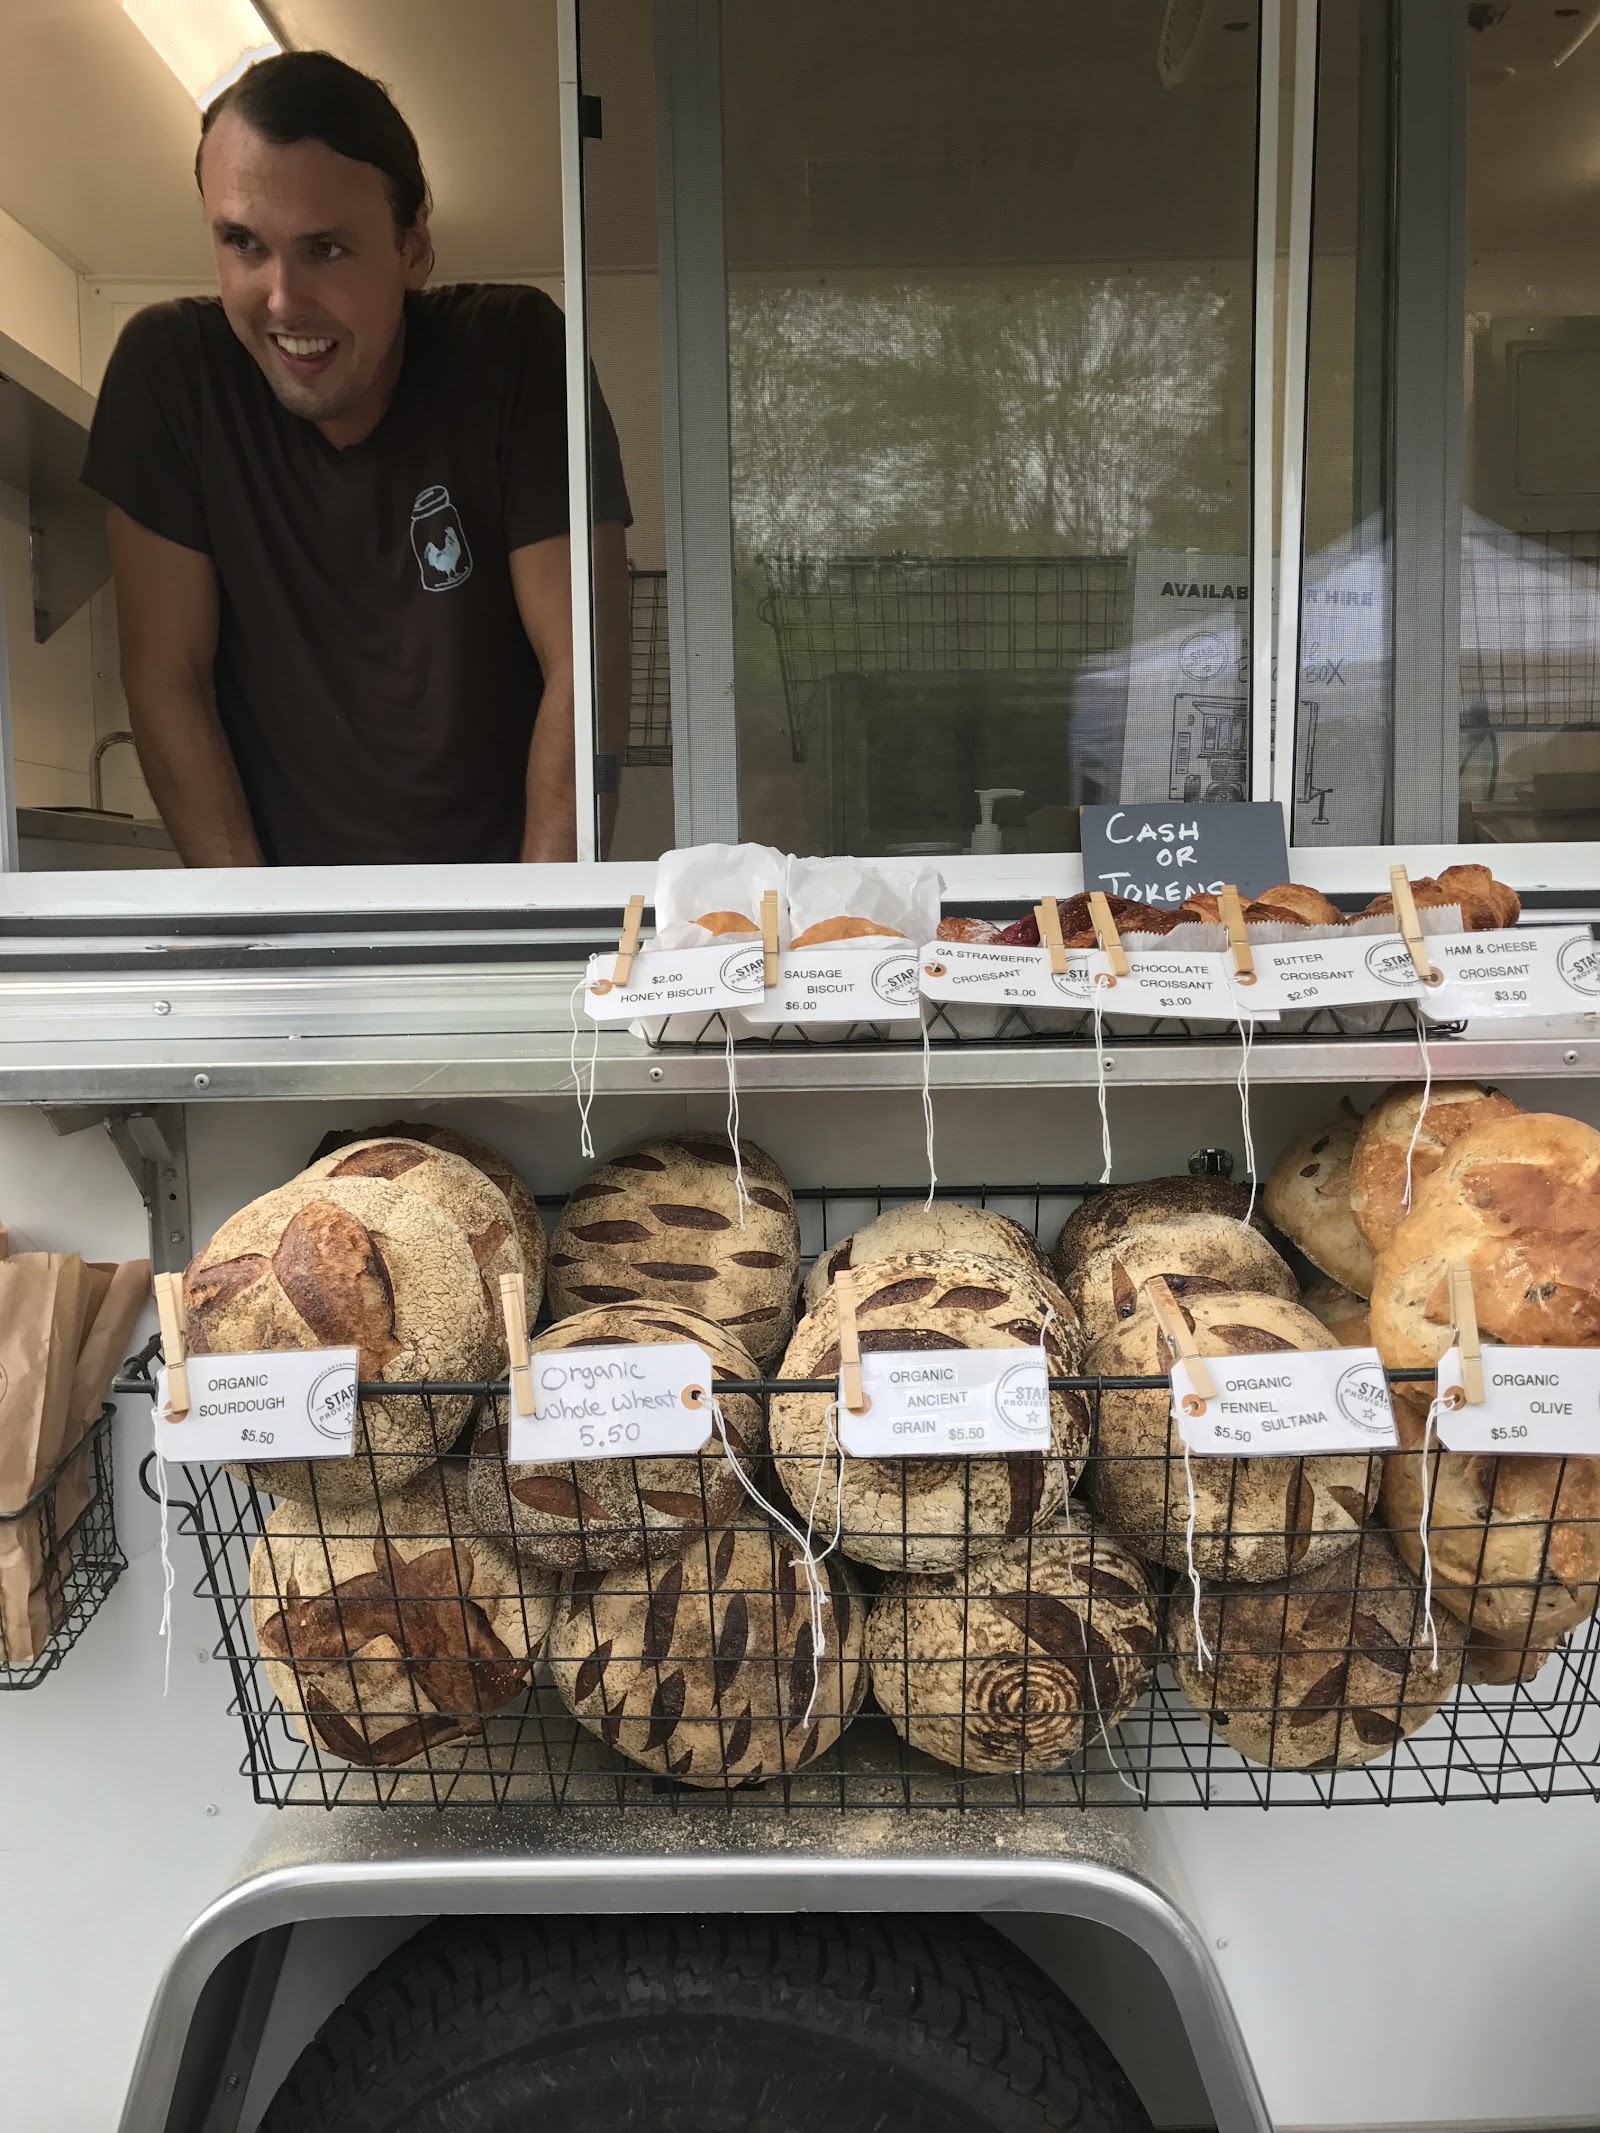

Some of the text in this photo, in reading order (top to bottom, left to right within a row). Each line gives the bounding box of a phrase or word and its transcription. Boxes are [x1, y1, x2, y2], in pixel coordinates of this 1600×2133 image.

[1161, 582, 1250, 600] AVAILAB
[1326, 589, 1373, 606] HIRE
[1105, 812, 1199, 844] CASH
[1156, 845, 1198, 867] OR
[935, 948, 1042, 964] GA STRAWBERRY
[1445, 941, 1538, 957] HAM & CHEESE
[1273, 953, 1324, 966] BUTTER
[784, 968, 842, 979] SAUSAGE
[952, 969, 1020, 984] CROISSANT
[1131, 964, 1209, 974] CHOCOLATE
[1280, 971, 1354, 981] CROISSANT
[1459, 965, 1530, 979] CROISSANT
[651, 973, 683, 985] $2.00
[1140, 979, 1213, 990] CROISSANT
[620, 986, 715, 1003] HONEY BISCUIT
[807, 983, 855, 994] BISCUIT
[1004, 987, 1036, 998] $3.00
[1287, 987, 1319, 1001] $2.00
[1495, 990, 1527, 1002] $3.50
[785, 1000, 817, 1011] $6.00
[1160, 997, 1192, 1007] $3.00
[208, 1374, 268, 1391] ORGANIC
[541, 1362, 645, 1390] Organic
[889, 1368, 954, 1383] ORGANIC
[1492, 1374, 1560, 1386] ORGANIC
[1225, 1376, 1292, 1392] ORGANIC
[907, 1391, 968, 1408] ANCIENT
[1359, 1382, 1388, 1403] STA
[199, 1397, 285, 1417] SOURDOUGH
[1220, 1402, 1278, 1414] FENNEL
[1530, 1401, 1573, 1415] OLIVE
[892, 1420, 936, 1434] GRAIN
[1261, 1411, 1328, 1432] SULTANA
[241, 1429, 274, 1444] $5.50
[579, 1422, 640, 1447] 5.50
[948, 1427, 985, 1441] $5.50
[1214, 1425, 1251, 1442] $5.50
[1491, 1425, 1528, 1440] $5.50
